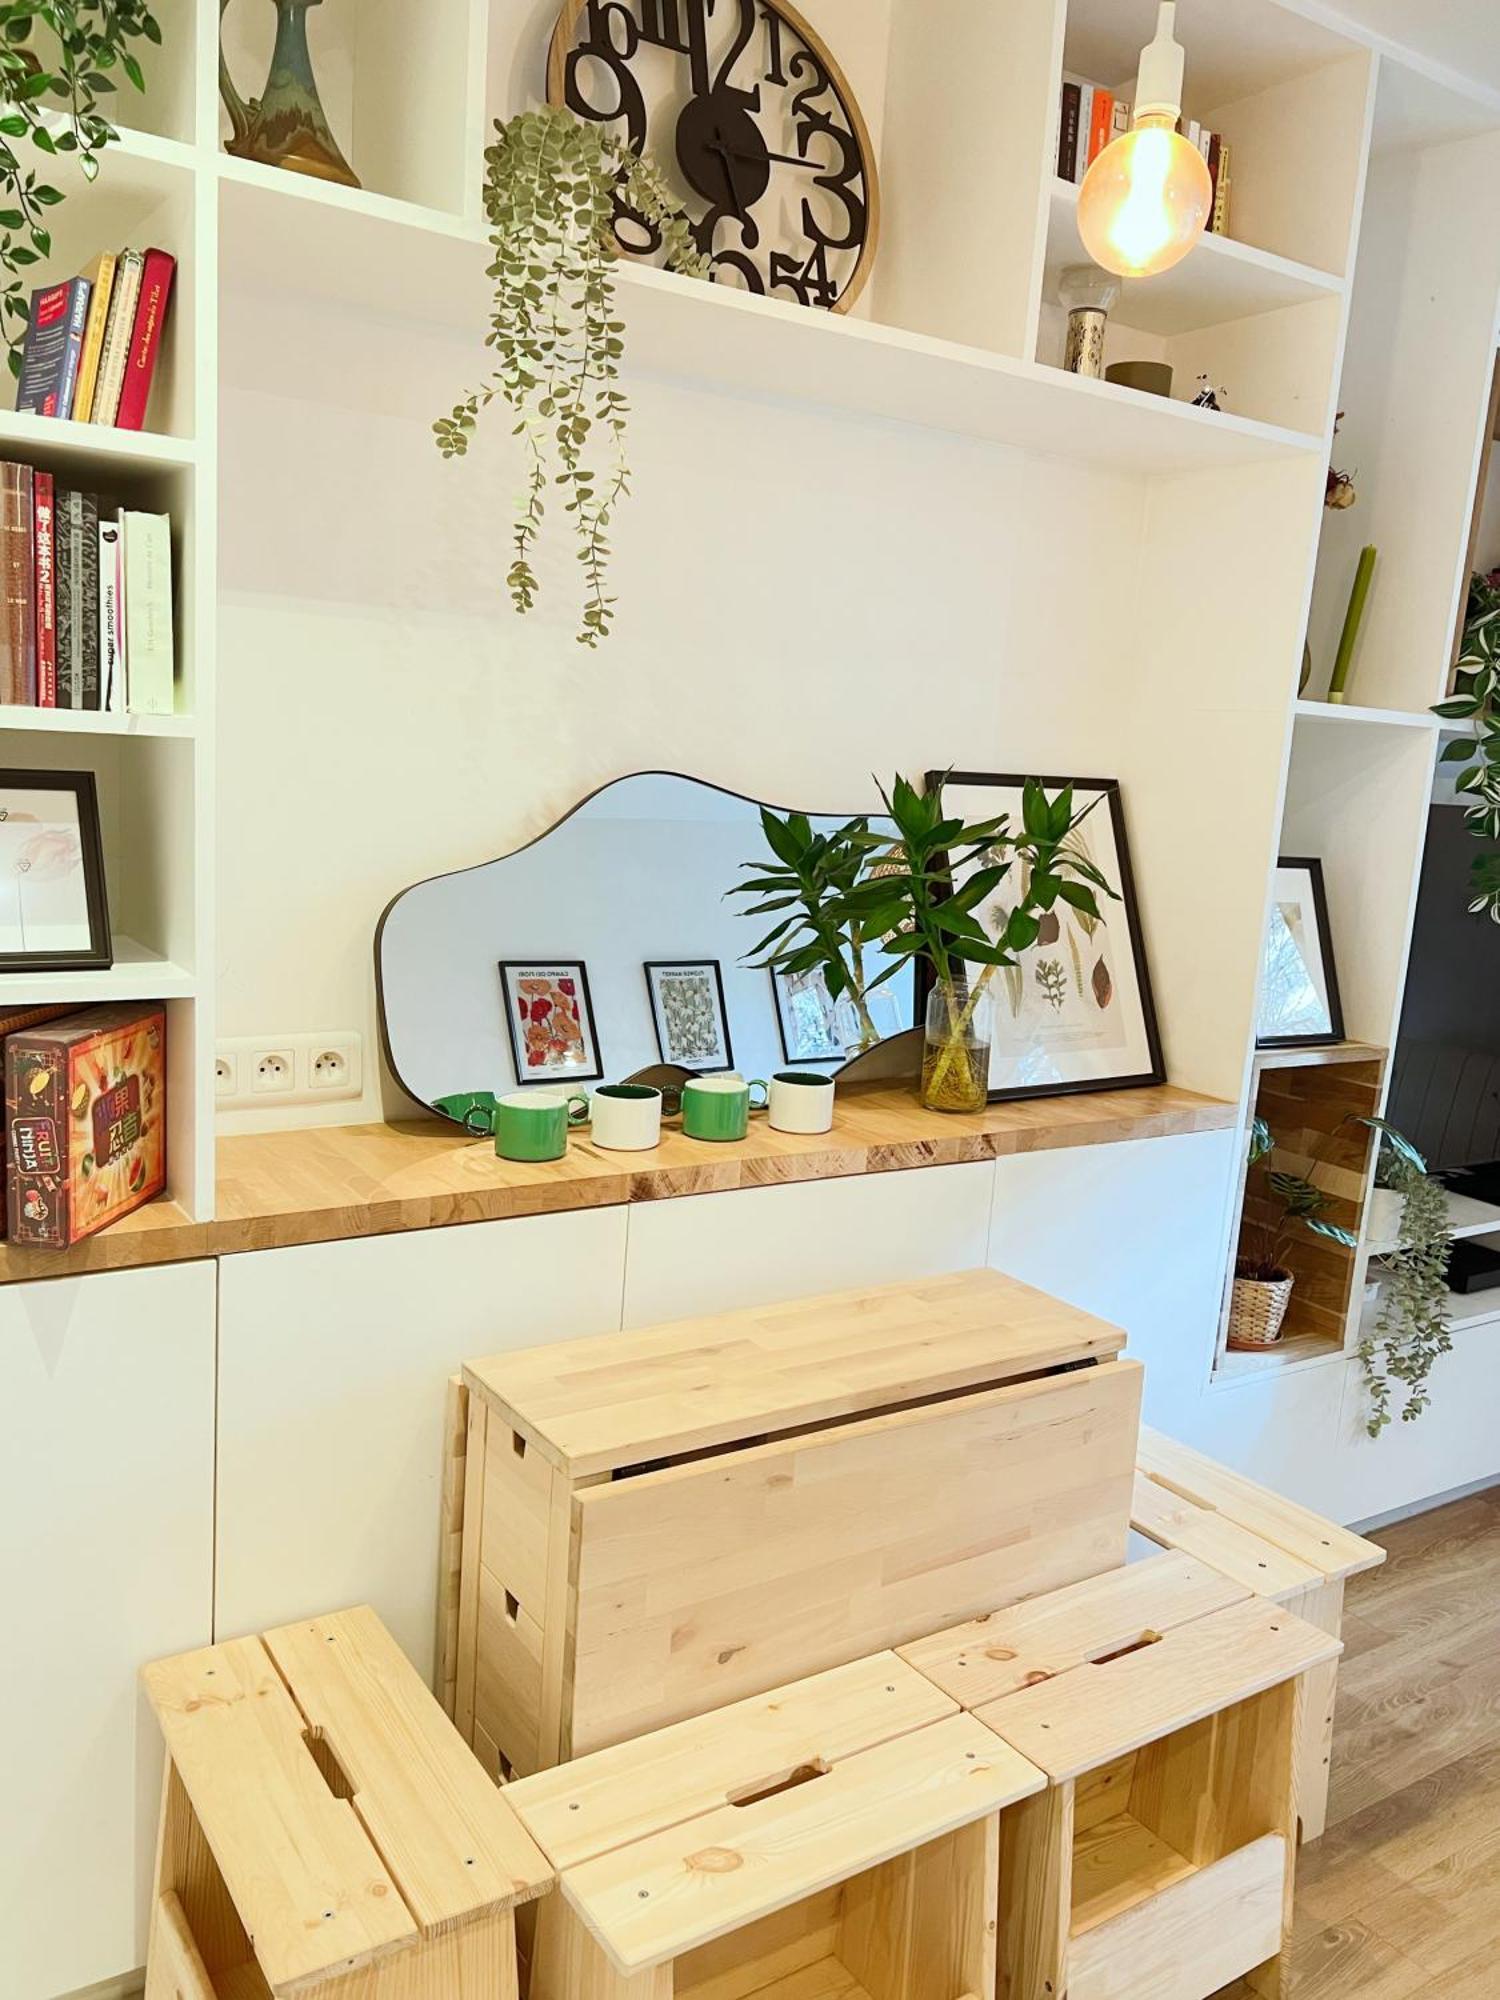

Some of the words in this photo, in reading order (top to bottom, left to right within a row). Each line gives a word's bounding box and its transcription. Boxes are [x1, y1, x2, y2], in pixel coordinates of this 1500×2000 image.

[760, 10, 789, 87] 1
[565, 50, 647, 184] 9
[789, 51, 832, 123] 2
[797, 118, 868, 249] 3
[800, 243, 837, 311] 4
[106, 584, 114, 635] smoothies
[19, 1127, 38, 1170] NINJA
[35, 1120, 54, 1166] FRUIT
